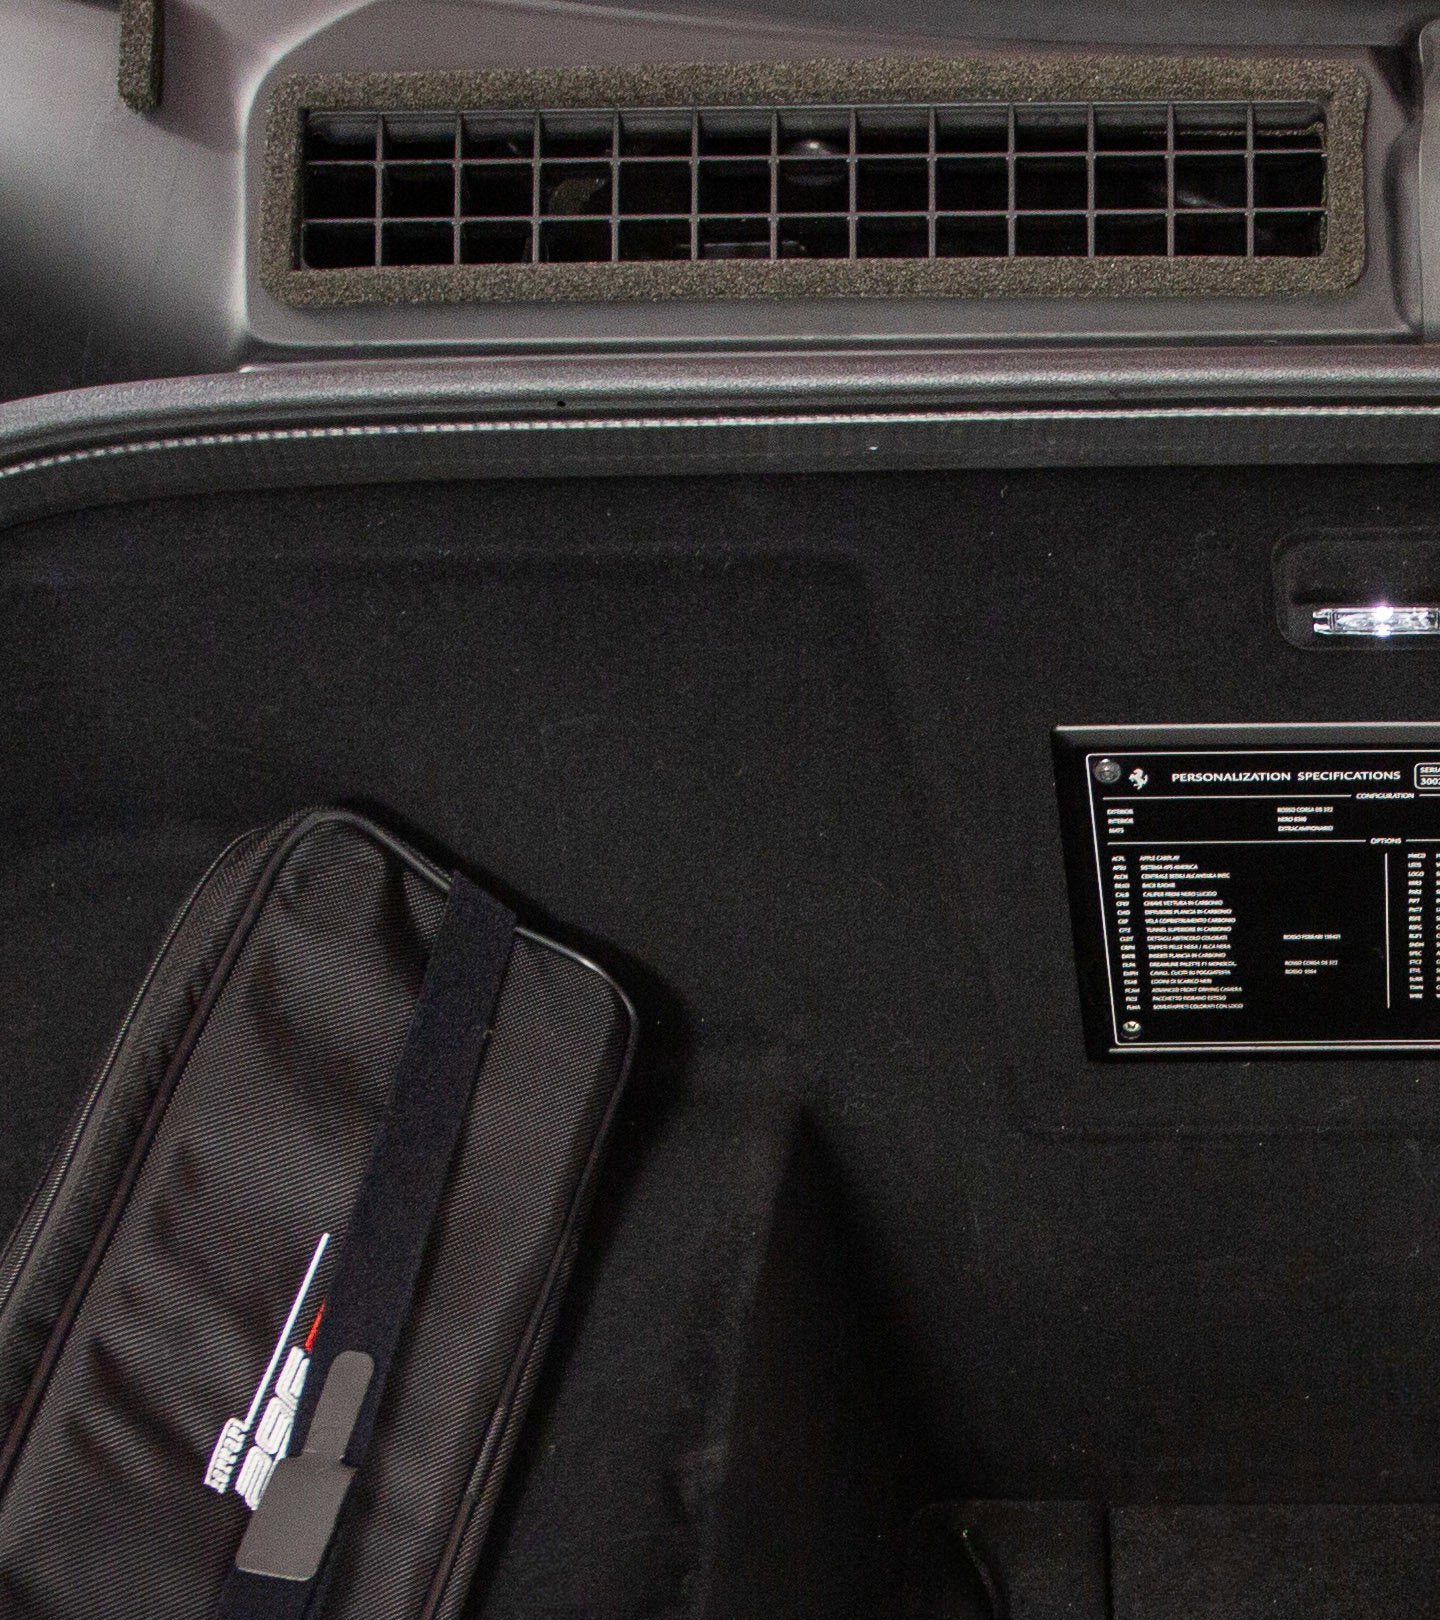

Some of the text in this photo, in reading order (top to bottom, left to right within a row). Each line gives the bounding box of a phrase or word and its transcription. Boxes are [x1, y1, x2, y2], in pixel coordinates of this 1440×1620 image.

[1171, 771, 1401, 783] PERSONALIZATION SPECIFICATIONS
[1356, 792, 1415, 800] CONFIGURATION
[1370, 837, 1402, 845] OPTIONS
[203, 1417, 247, 1495] Ferrari
